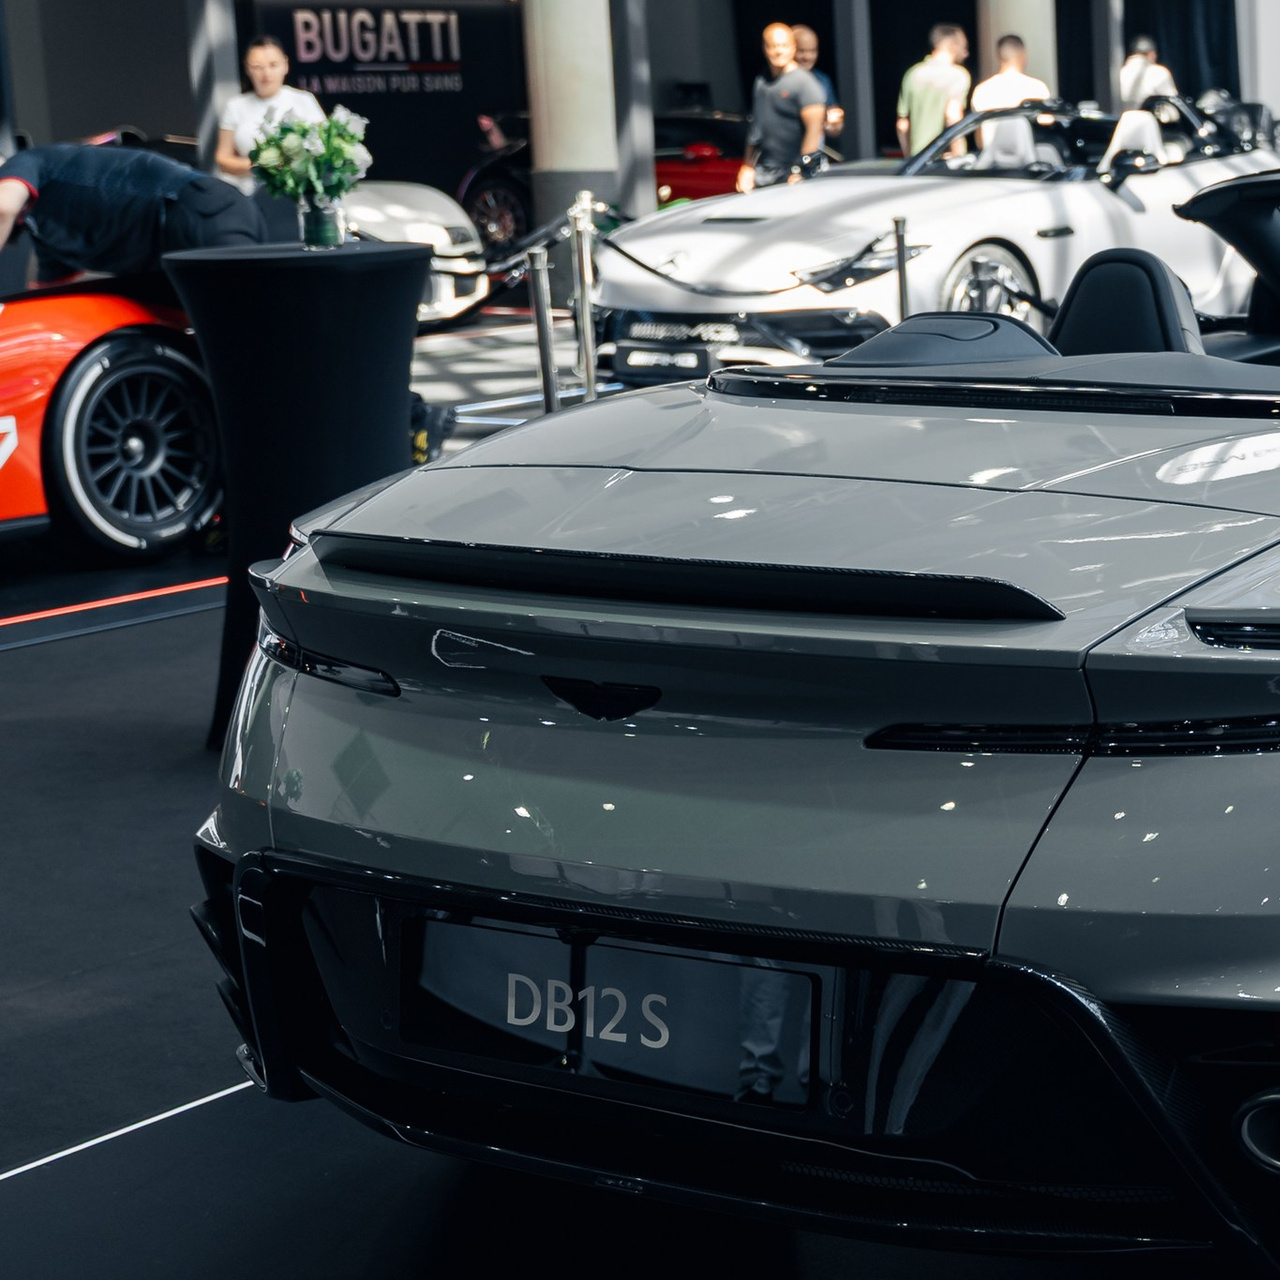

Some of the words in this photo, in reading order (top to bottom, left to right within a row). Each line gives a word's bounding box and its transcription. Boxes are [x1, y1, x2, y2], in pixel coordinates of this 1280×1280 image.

[293, 8, 461, 63] BUGATTI
[506, 973, 627, 1043] DB12
[640, 993, 670, 1049] S
